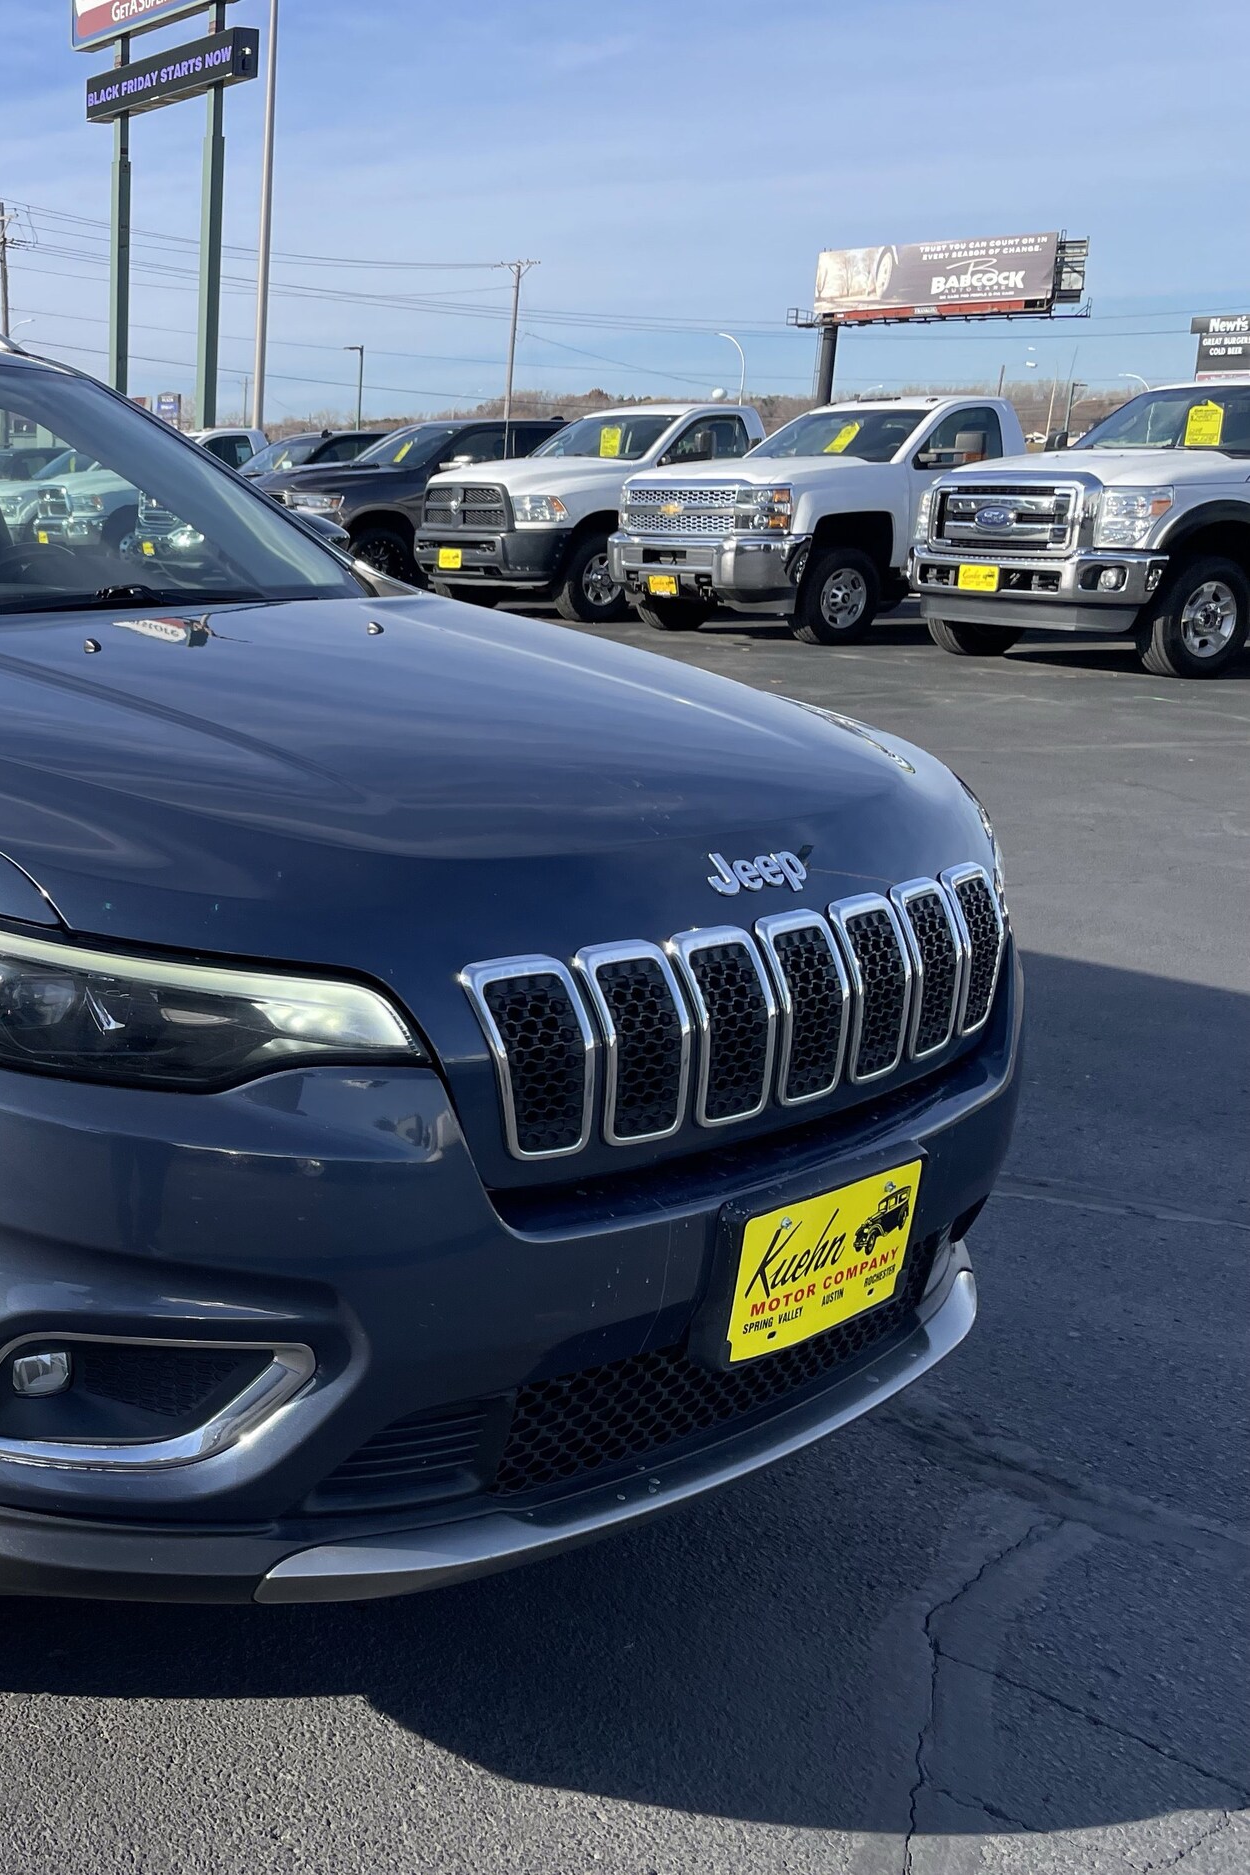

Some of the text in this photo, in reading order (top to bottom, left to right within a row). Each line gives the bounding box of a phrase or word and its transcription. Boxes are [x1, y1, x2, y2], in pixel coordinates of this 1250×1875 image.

[87, 45, 233, 107] BLACK FRIDAY STARTS NOW
[919, 245, 946, 253] TRUST
[949, 243, 966, 251] YOU
[969, 241, 987, 249] CAN
[989, 238, 1020, 247] COUNT
[922, 252, 949, 261] EVERY
[951, 249, 986, 258] SEASON
[930, 270, 1026, 295] BABCOCK
[1209, 315, 1249, 333] Newt's
[1202, 337, 1223, 346] GREAT
[1209, 346, 1243, 356] COLD BEER
[707, 851, 807, 896] Jeep
[744, 1208, 847, 1299] Kuehn
[750, 1246, 899, 1317] MOTOR COMPANY
[742, 1264, 896, 1335] SPRING VALLEY AUSTIN ROCHESTER
